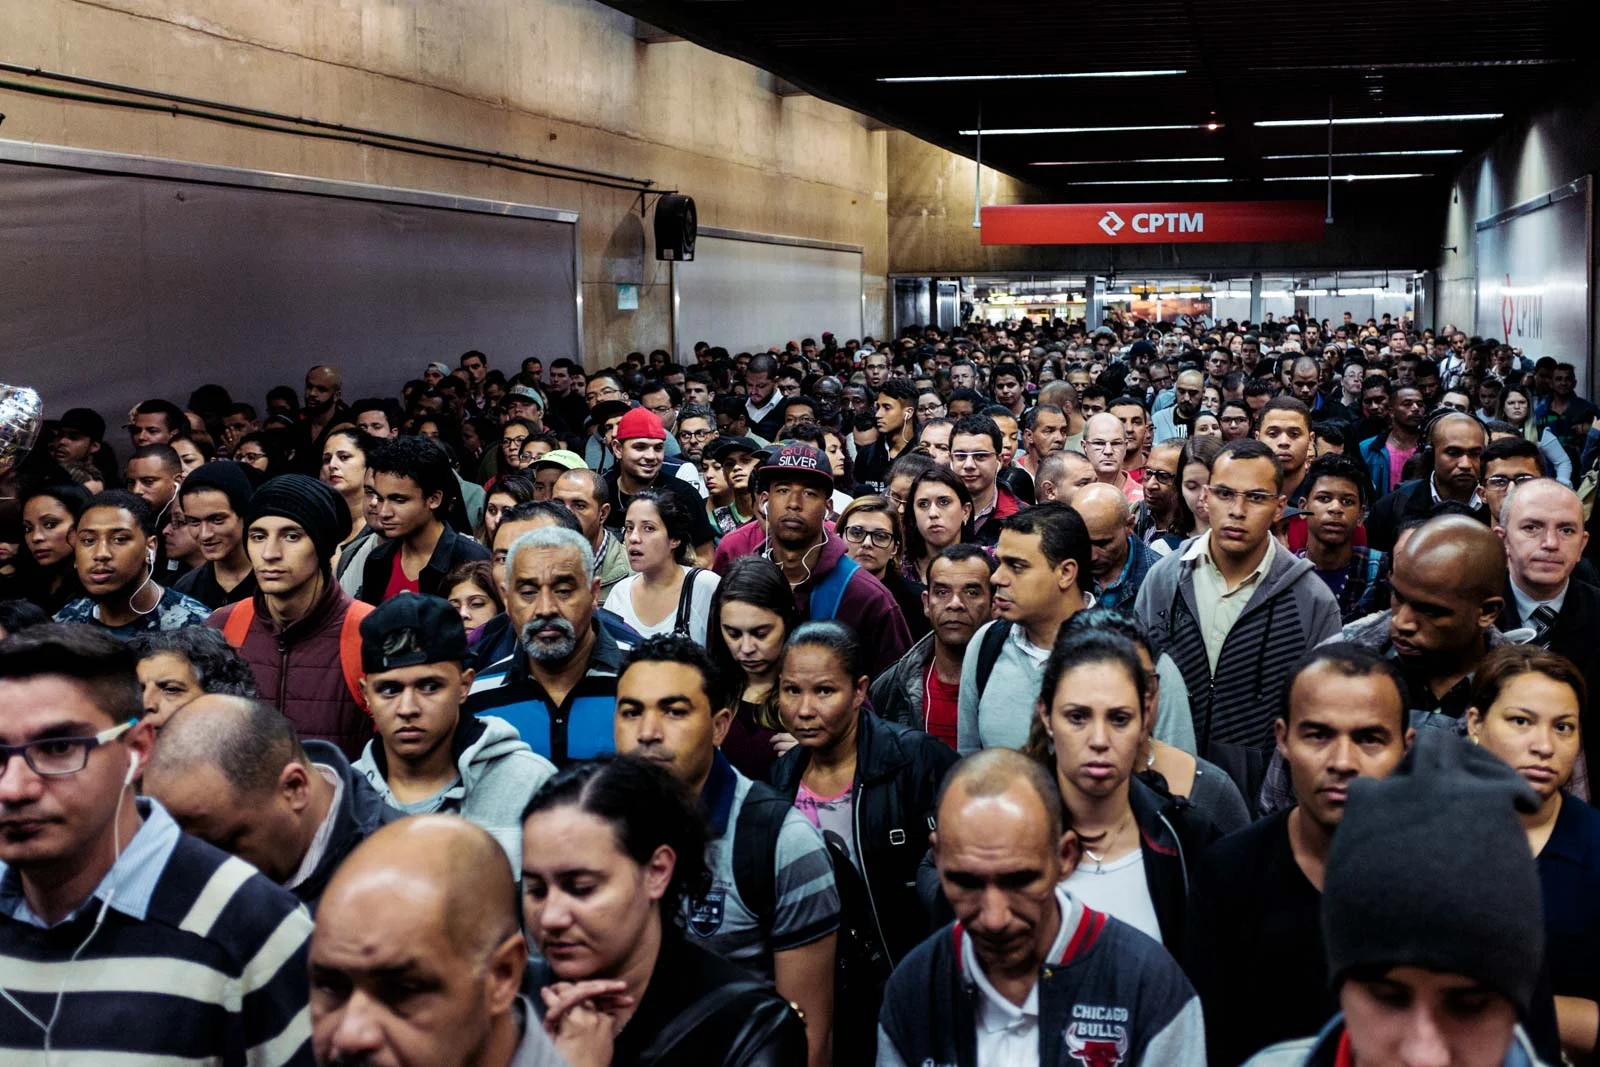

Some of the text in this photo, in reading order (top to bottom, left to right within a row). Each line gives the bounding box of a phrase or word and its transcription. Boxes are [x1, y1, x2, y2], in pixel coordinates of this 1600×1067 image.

[1131, 213, 1203, 233] CPTM
[1516, 294, 1543, 339] CPTM
[778, 456, 817, 468] SILVER
[1072, 1004, 1128, 1021] CHICAGO
[1077, 1022, 1123, 1038] BULLS
